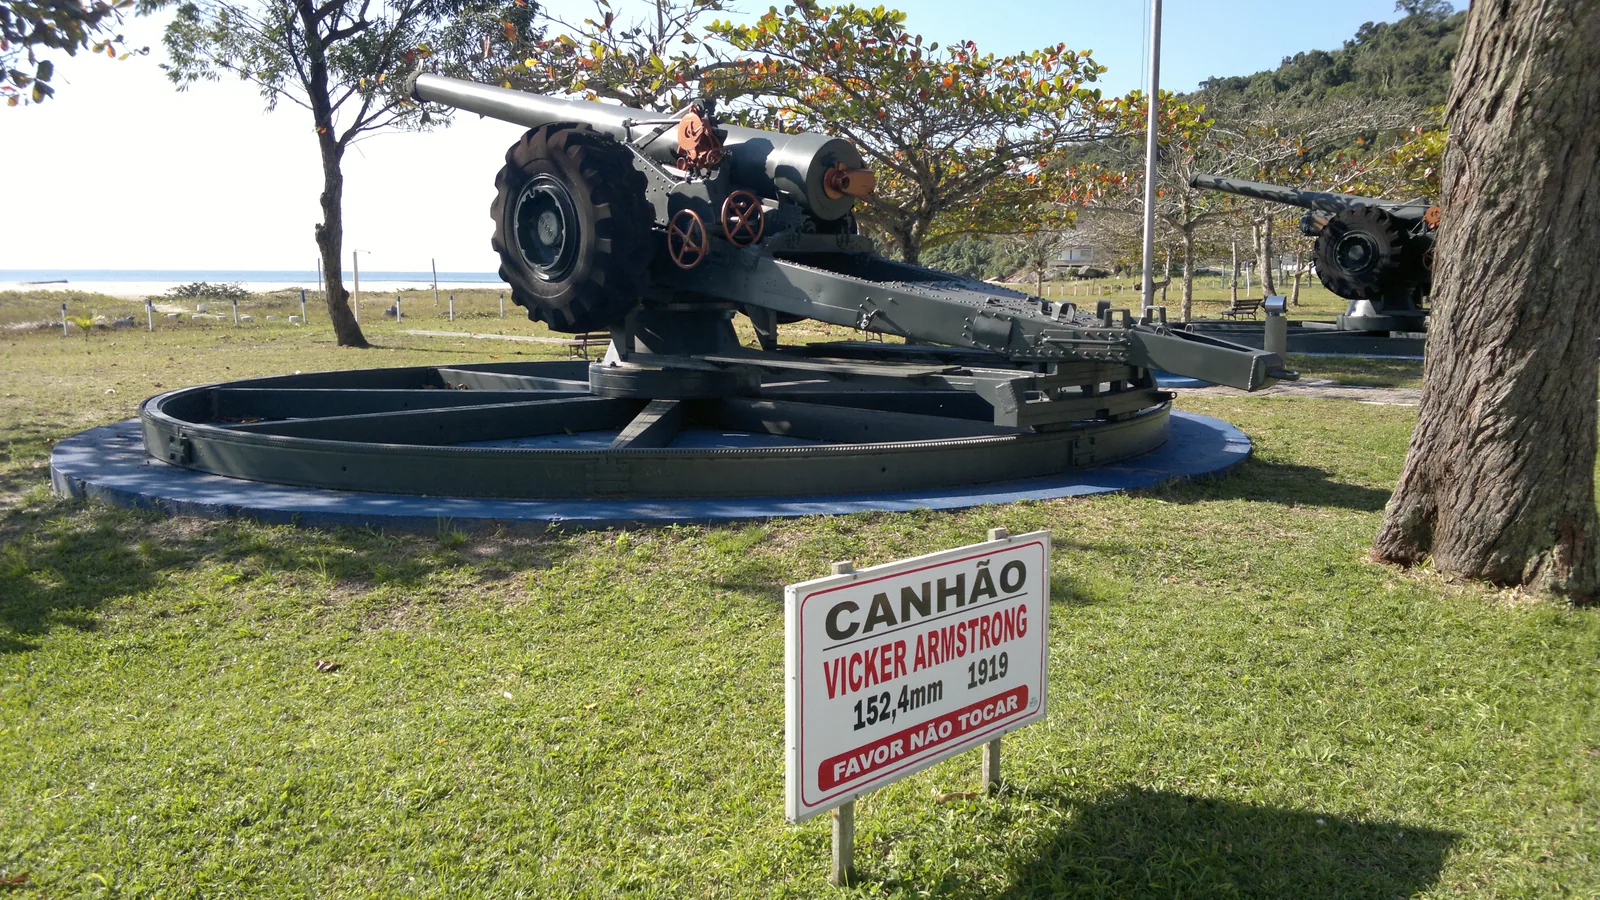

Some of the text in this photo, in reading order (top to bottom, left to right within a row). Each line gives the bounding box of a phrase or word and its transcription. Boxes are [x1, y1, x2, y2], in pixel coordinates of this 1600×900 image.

[825, 559, 1027, 640] CANHÃO
[823, 604, 1028, 700] VICKER ARMSTRONG
[853, 651, 1008, 731] 152,4mm 1919
[833, 694, 1018, 782] FAVOR NÃO TOCAR
